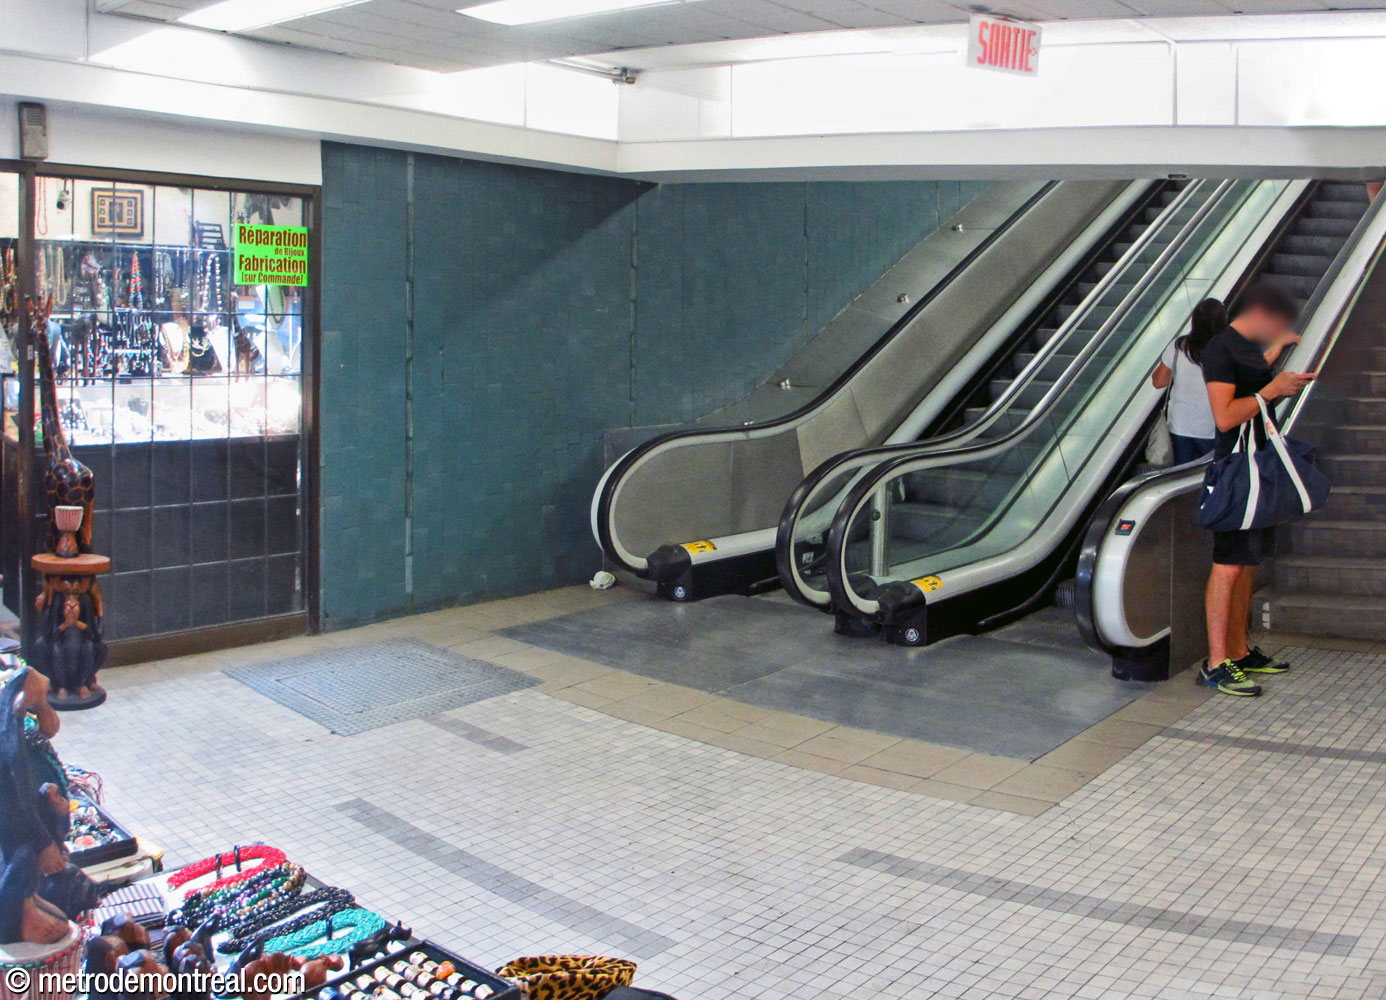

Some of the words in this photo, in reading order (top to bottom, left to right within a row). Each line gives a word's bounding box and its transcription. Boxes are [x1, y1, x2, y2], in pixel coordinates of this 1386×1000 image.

[977, 21, 1037, 72] SORTIE
[239, 225, 308, 248] Réparation
[274, 247, 283, 255] de
[284, 248, 305, 257] Bijoux
[239, 254, 307, 274] Fabrication
